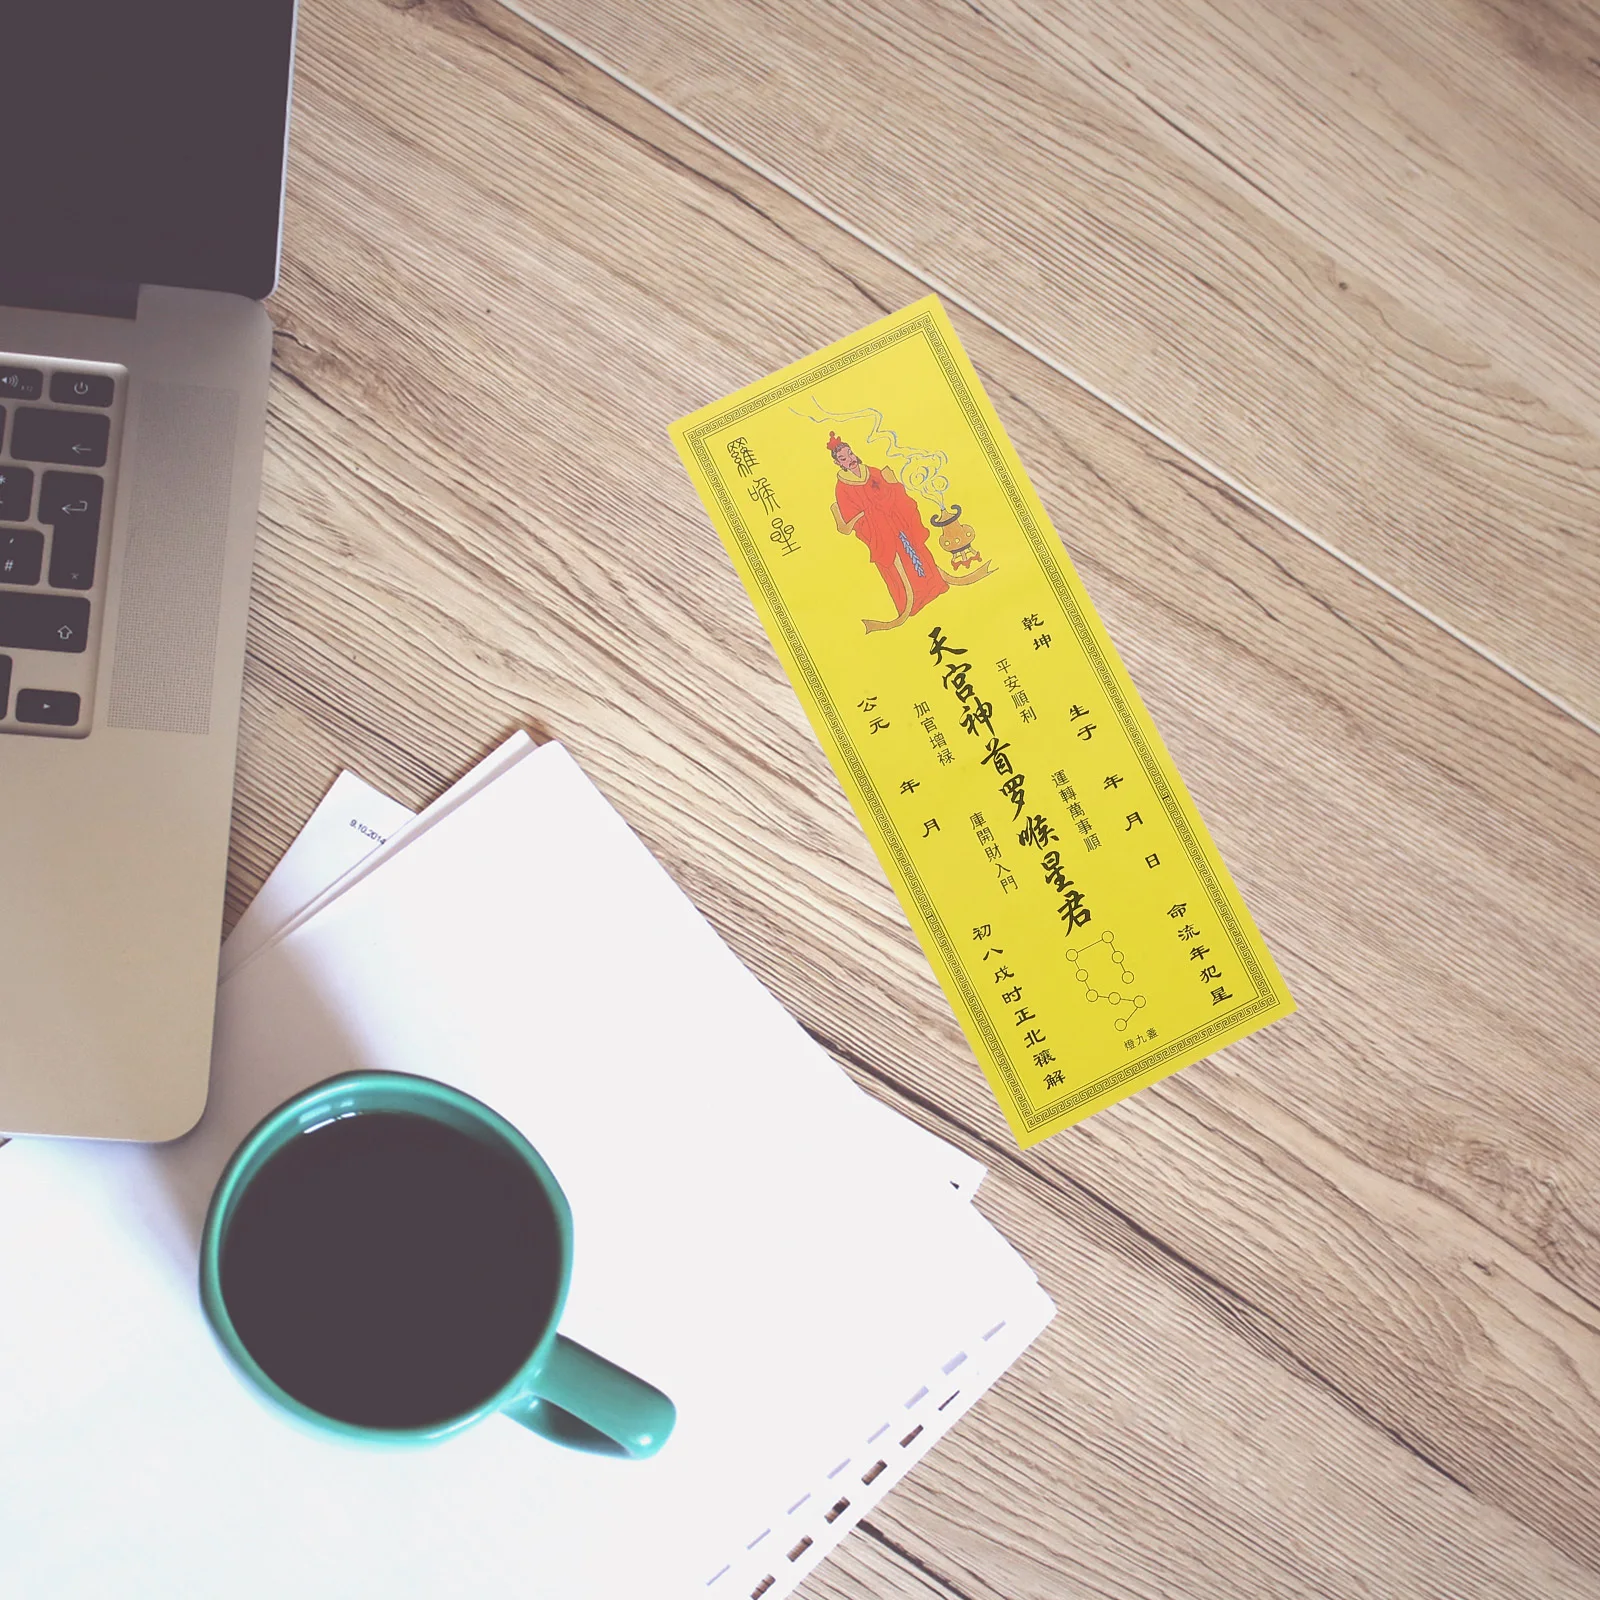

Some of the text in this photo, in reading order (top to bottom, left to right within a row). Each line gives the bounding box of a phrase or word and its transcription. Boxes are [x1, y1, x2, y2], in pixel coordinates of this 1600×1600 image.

[996, 658, 1037, 723] 平安順利
[857, 696, 890, 734] 公元
[900, 779, 920, 794] 年
[923, 818, 940, 838] 月
[914, 701, 955, 766] 加官增禄
[1022, 614, 1233, 1006] 乾坤 生于 年 月 日 命流年犯星
[1051, 769, 1102, 852] 運轉萬事順
[970, 812, 1018, 894] 庫開財入門
